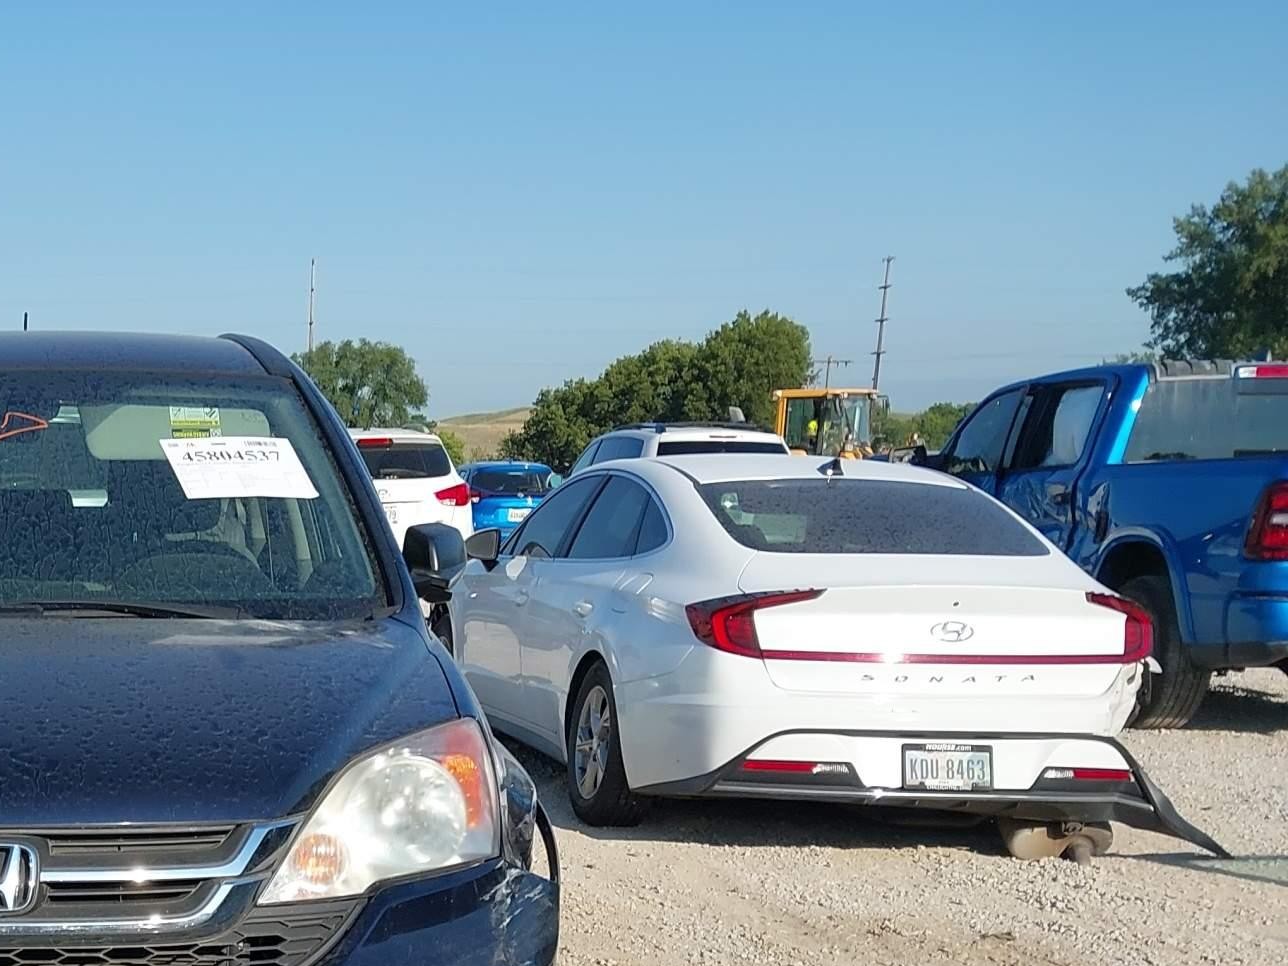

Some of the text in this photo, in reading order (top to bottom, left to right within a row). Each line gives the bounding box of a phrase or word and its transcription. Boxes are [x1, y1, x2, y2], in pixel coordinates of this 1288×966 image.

[181, 450, 281, 463] 45804537
[860, 673, 1036, 684] SONATA
[909, 757, 986, 781] KDU 8463
